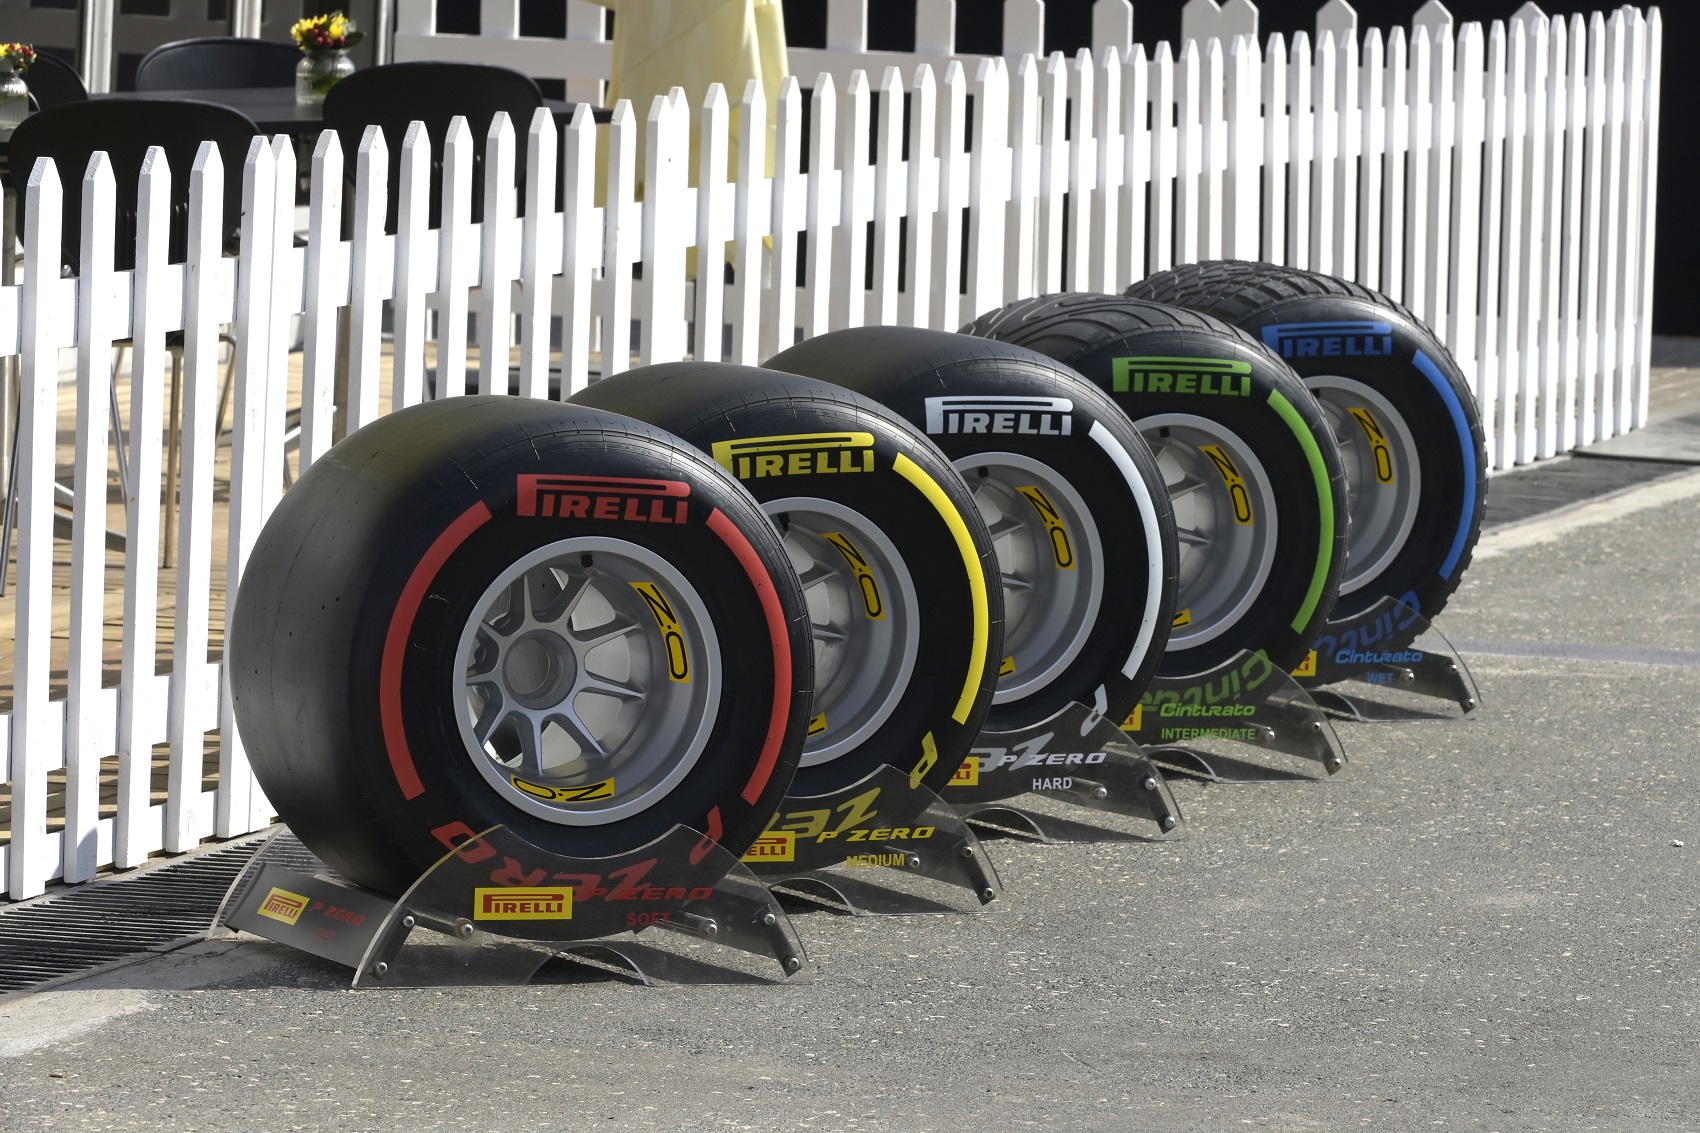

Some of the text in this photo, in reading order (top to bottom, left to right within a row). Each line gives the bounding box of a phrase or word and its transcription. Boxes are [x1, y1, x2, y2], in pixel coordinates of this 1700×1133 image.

[1261, 321, 1393, 358] PIRELLI
[1111, 356, 1253, 396] PIRELLI
[924, 395, 1074, 436] PIRELLI
[711, 431, 875, 480] PIRELLI
[516, 473, 691, 525] PIRELLI
[1335, 650, 1423, 664] Cinturato
[1367, 672, 1394, 684] WET
[1160, 702, 1256, 718] Cinturato
[1161, 727, 1256, 740] INTERMEDIATE
[997, 752, 1107, 766] P ZERO
[1032, 777, 1073, 790] HARD
[816, 827, 936, 844] P ZERO
[846, 853, 905, 868] MEDIUM
[619, 887, 713, 901] ZERO
[263, 893, 303, 919] PIRELLI
[482, 893, 565, 914] PIRELLI
[310, 901, 366, 927] P ZERO
[626, 912, 671, 926] SOFT
